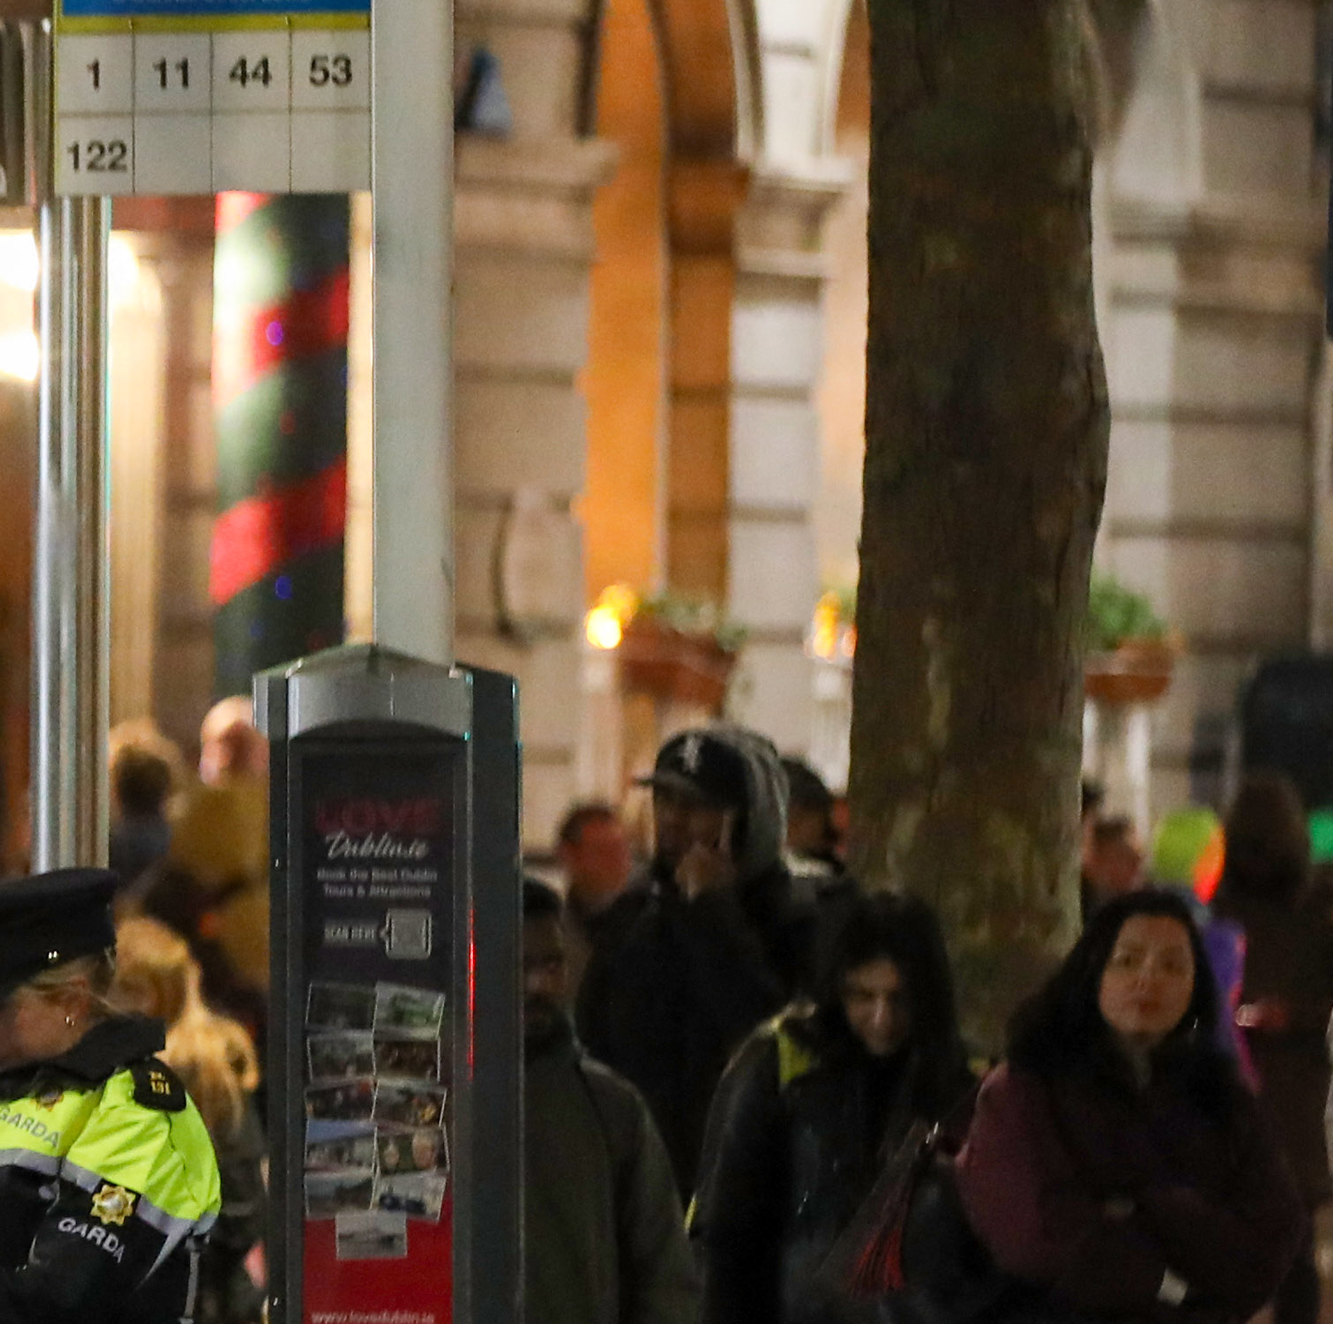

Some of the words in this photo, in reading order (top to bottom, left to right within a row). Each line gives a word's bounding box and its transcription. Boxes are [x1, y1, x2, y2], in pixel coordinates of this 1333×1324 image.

[87, 57, 100, 90] 1
[153, 57, 189, 90] 11
[229, 54, 272, 89] 44
[309, 53, 353, 87] 53
[67, 139, 128, 173] 122
[57, 1217, 126, 1264] GARDA
